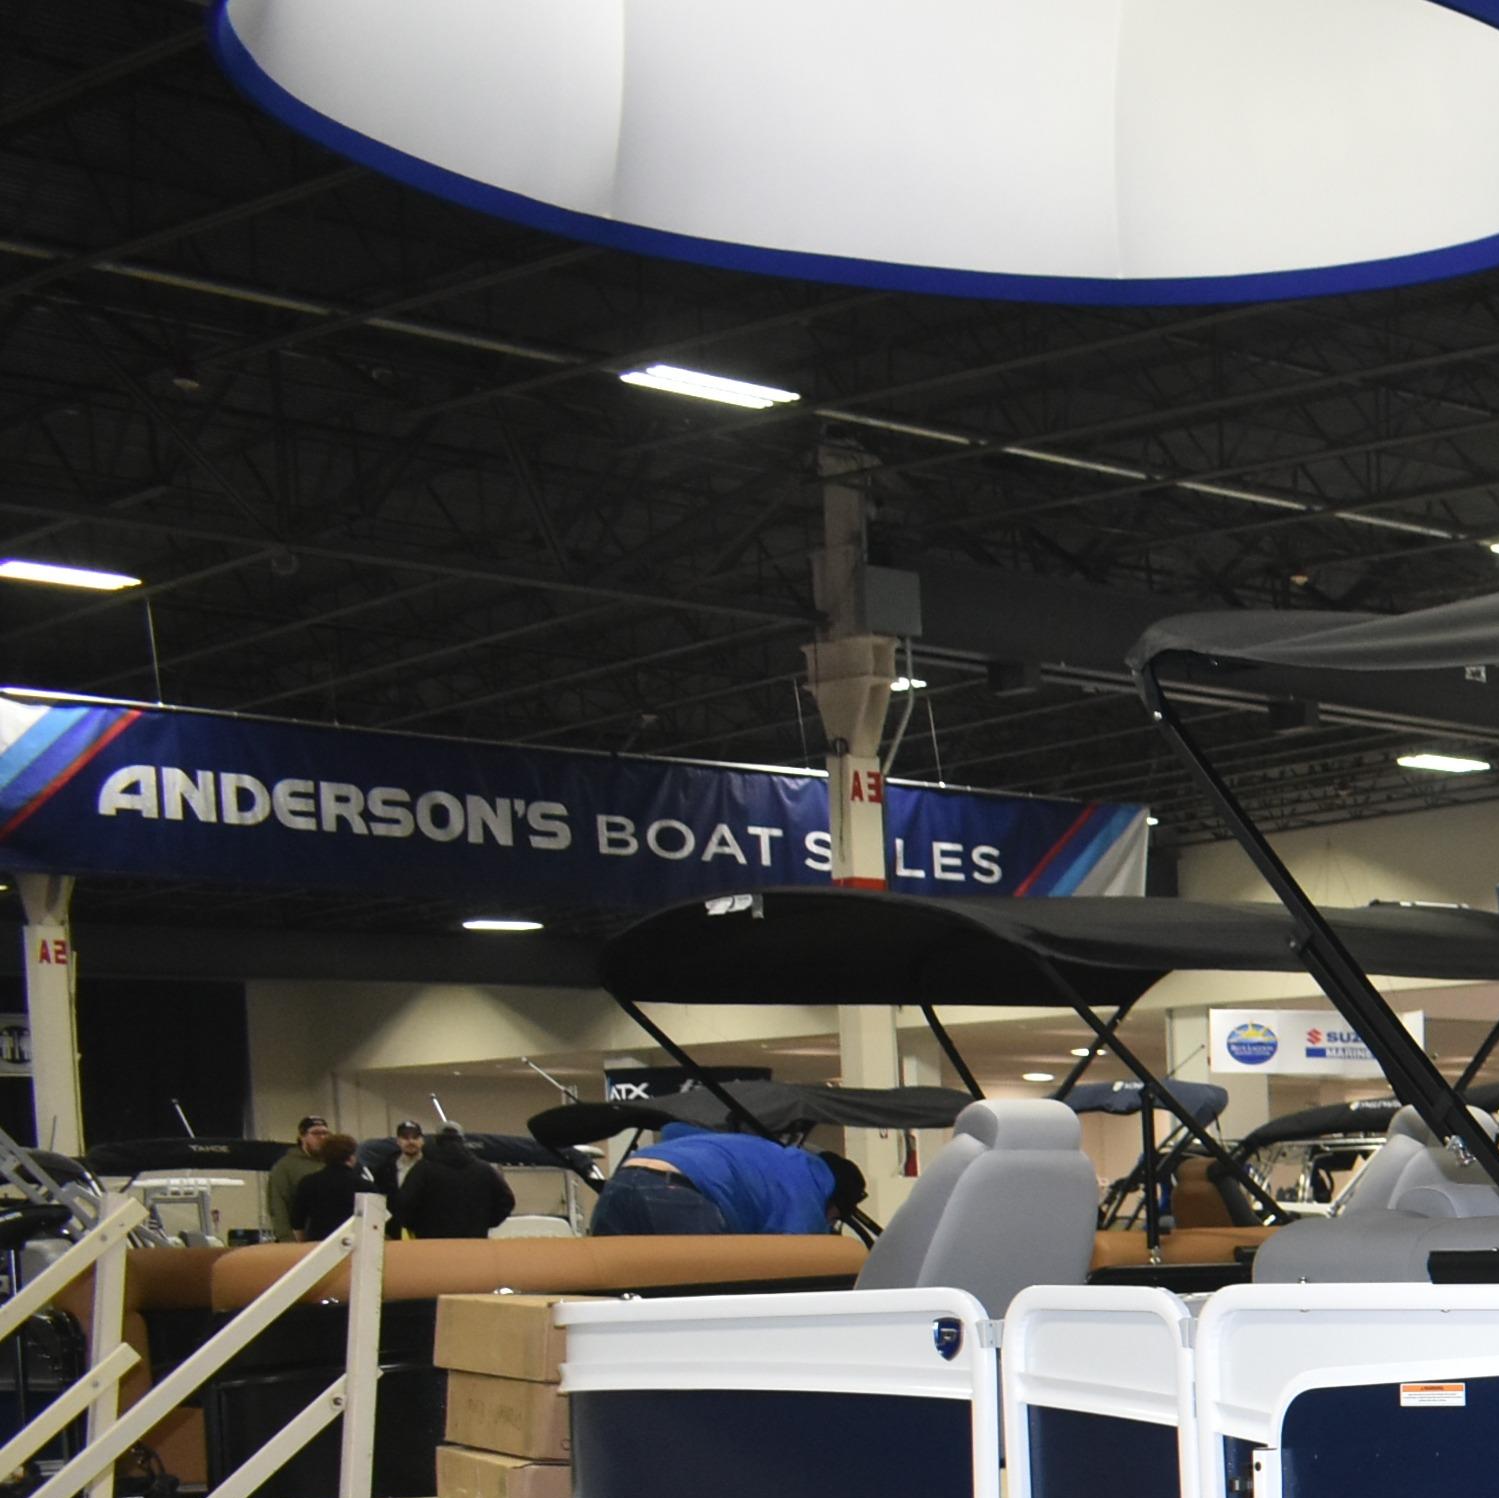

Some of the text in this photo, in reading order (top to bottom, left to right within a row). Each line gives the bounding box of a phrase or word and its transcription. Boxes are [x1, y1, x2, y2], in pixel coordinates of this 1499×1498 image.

[97, 764, 1002, 885] ANDERSON'S BOAT SLES
[610, 1082, 650, 1101] ATX
